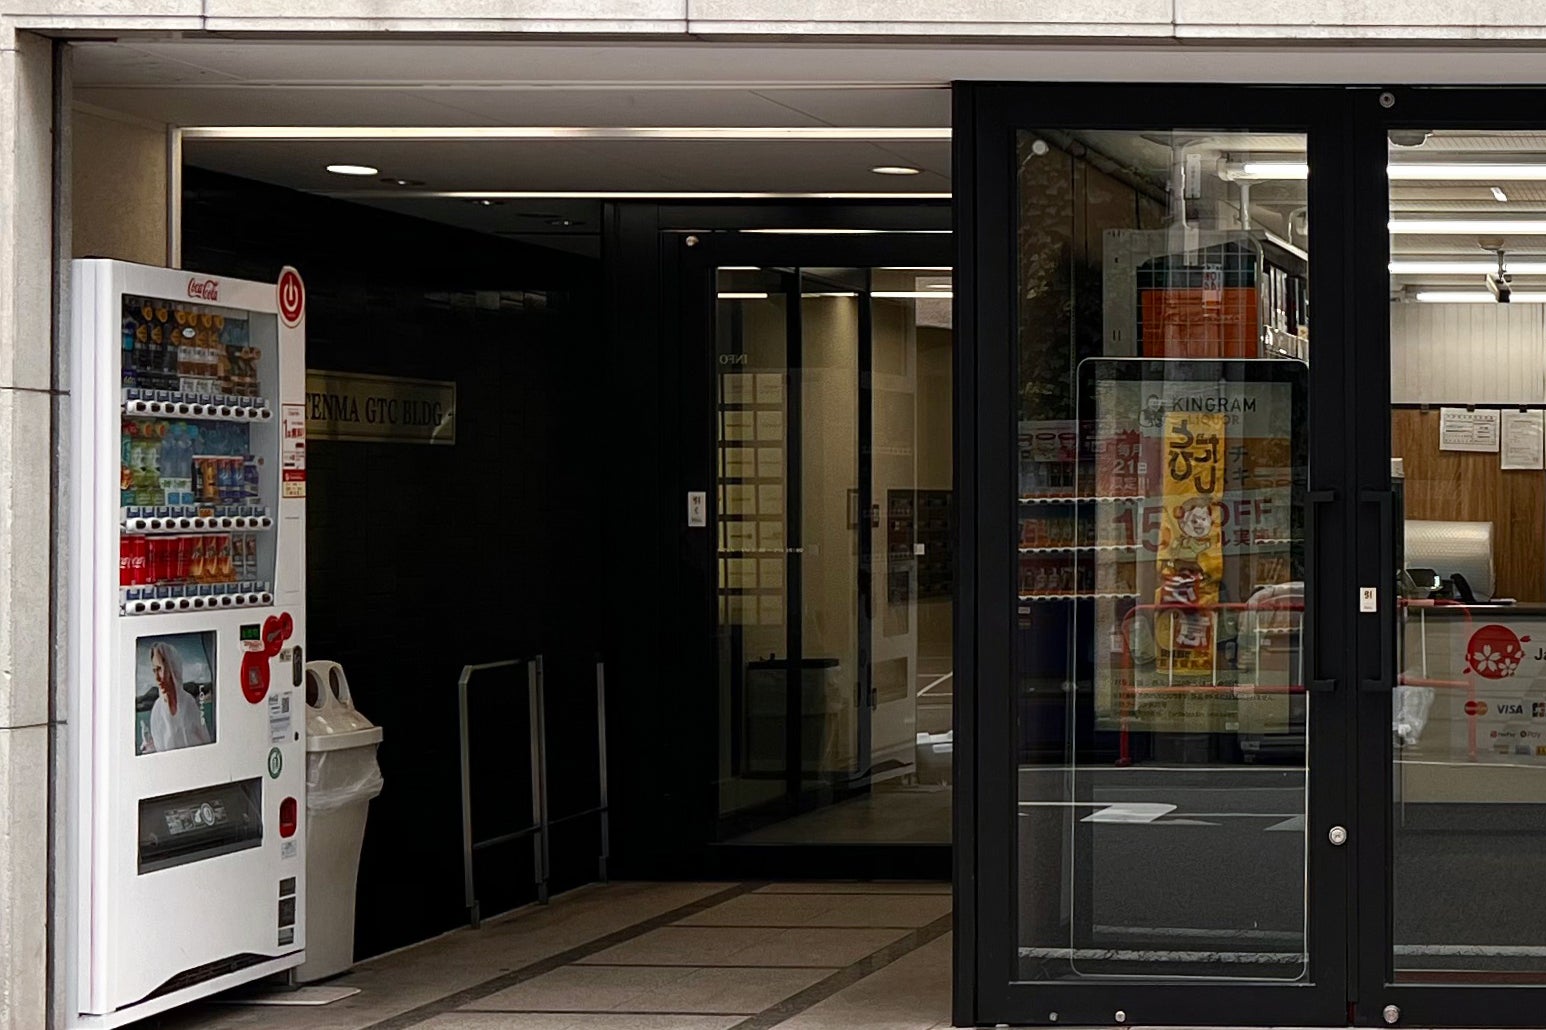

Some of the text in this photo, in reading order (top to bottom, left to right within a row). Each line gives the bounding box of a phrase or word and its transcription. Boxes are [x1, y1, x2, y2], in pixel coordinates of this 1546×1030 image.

[366, 396, 398, 424] GTC
[403, 400, 443, 426] BLDG
[1173, 397, 1256, 412] KINGRAM
[1497, 702, 1524, 715] VISA
